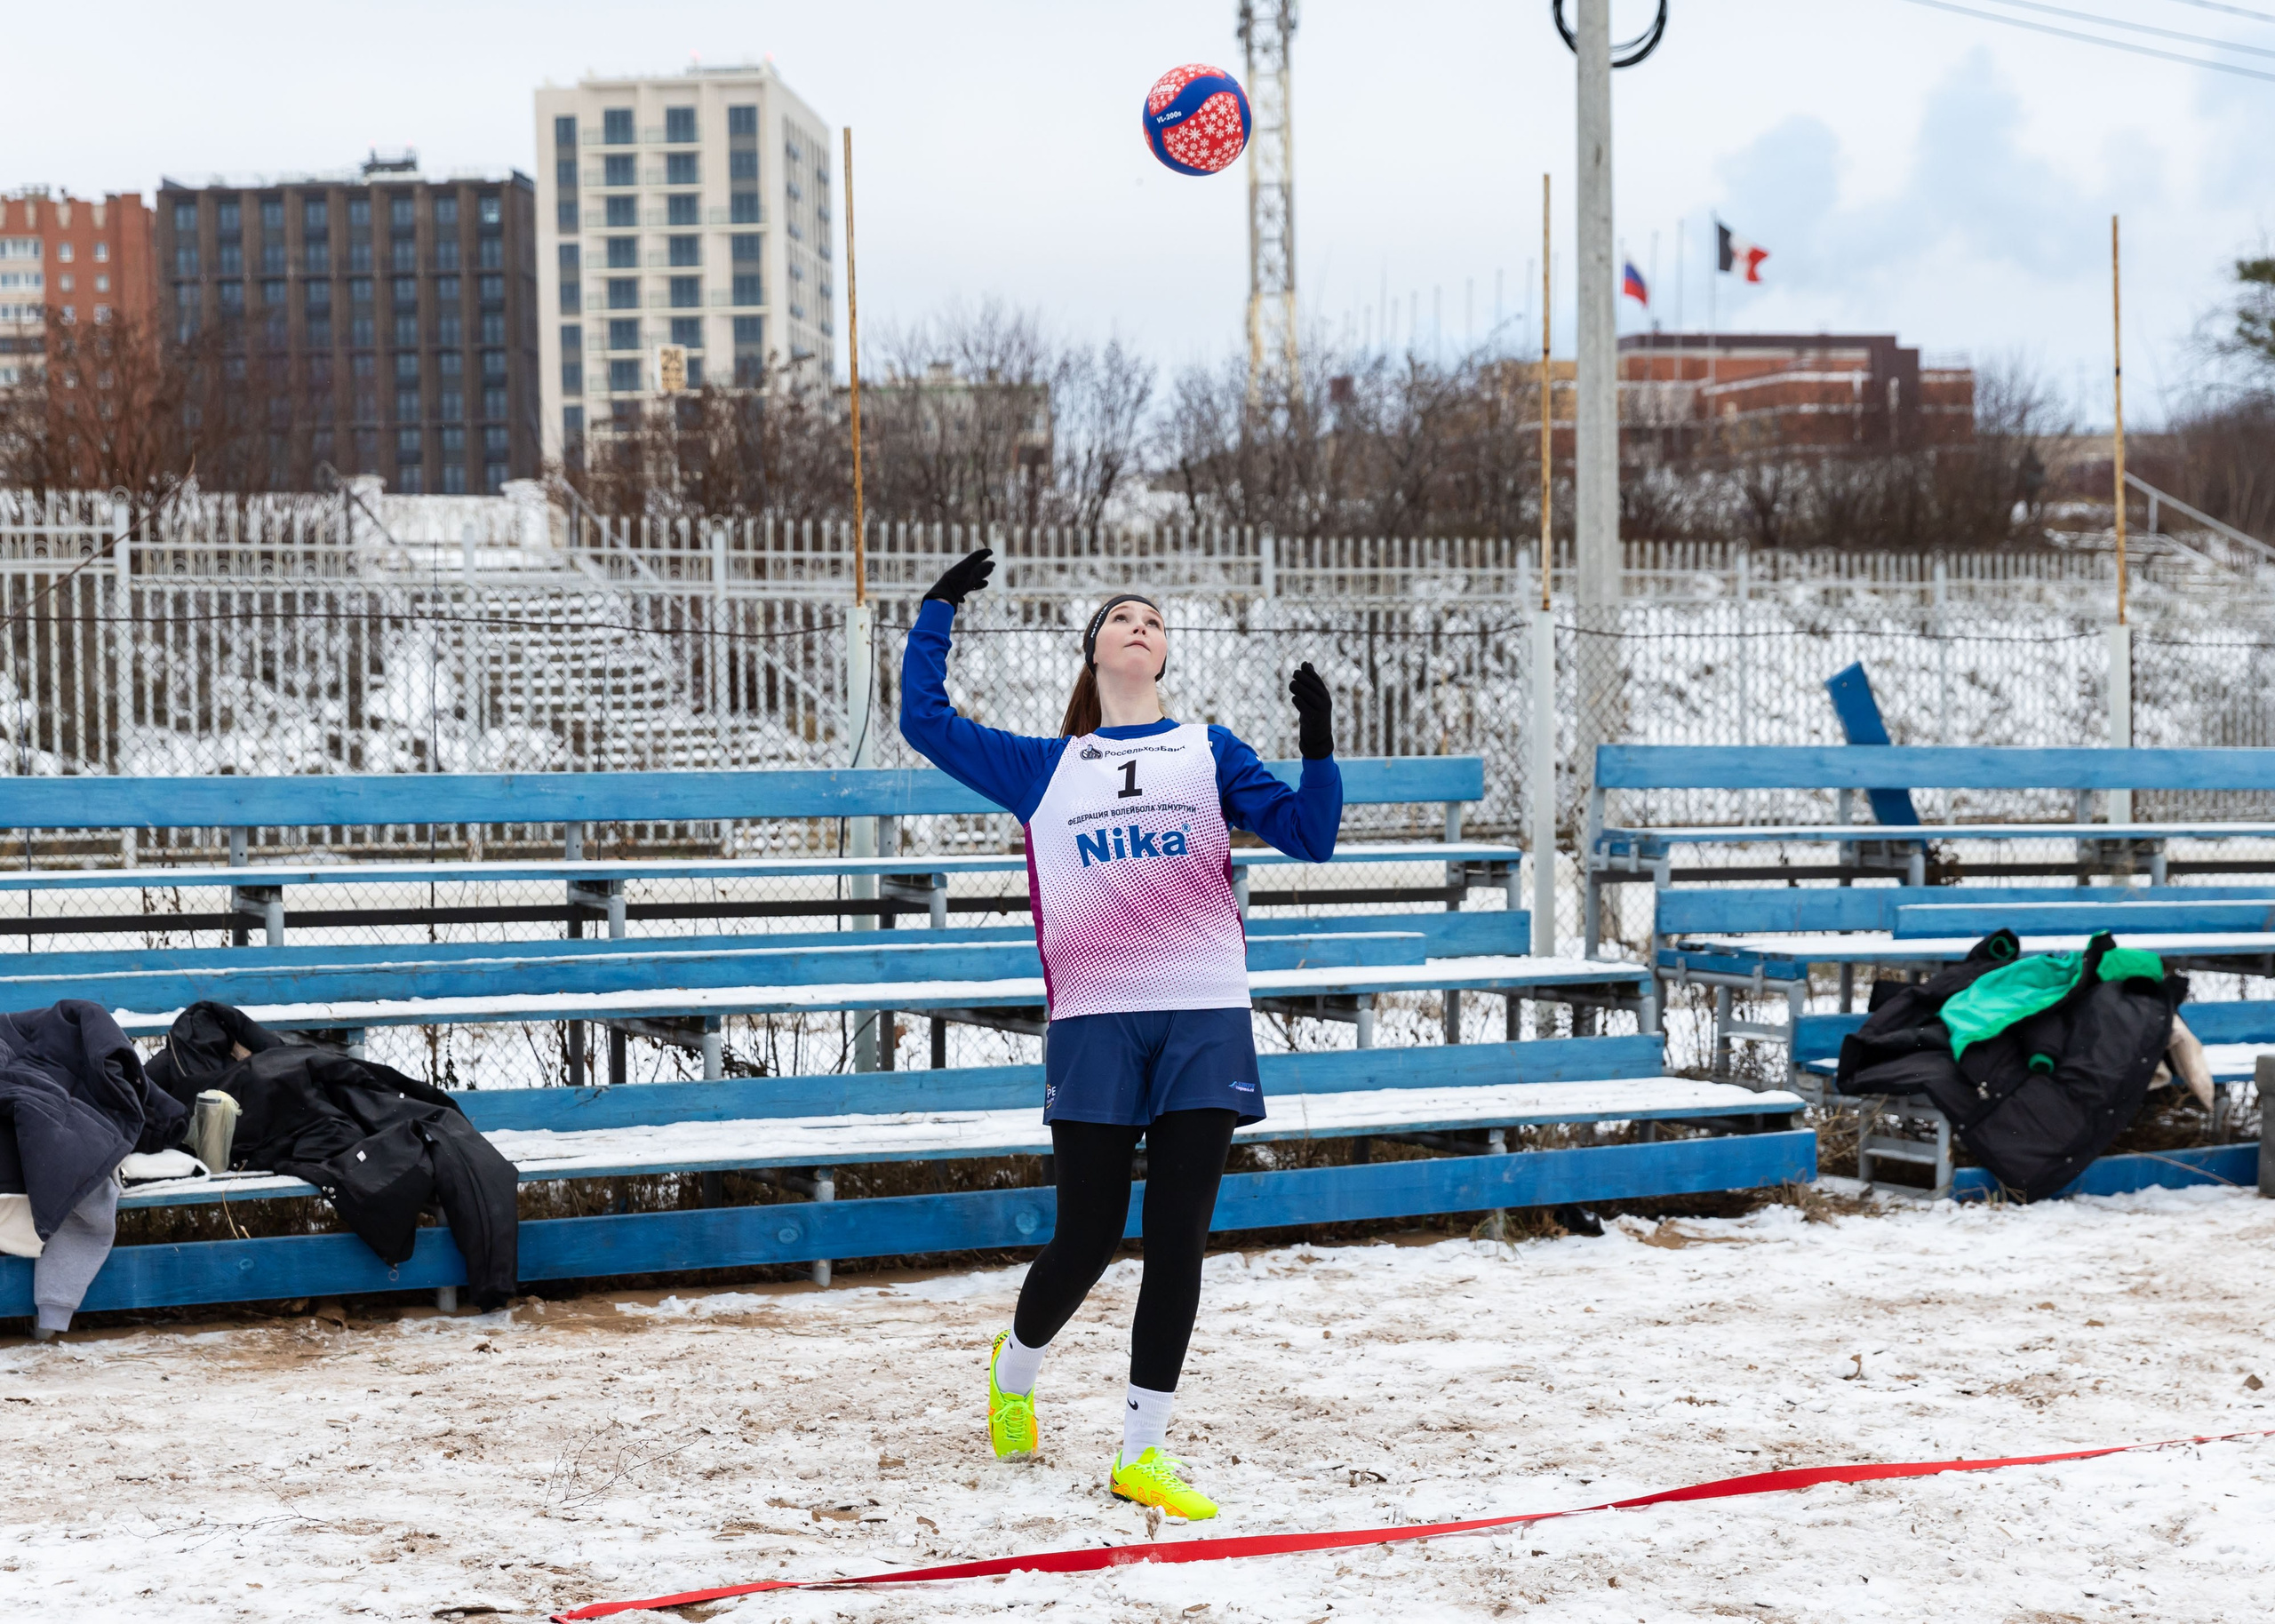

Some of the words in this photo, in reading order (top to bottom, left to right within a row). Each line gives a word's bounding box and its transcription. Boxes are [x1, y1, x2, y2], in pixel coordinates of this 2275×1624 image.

[1156, 111, 1182, 123] VL-200s
[1117, 760, 1143, 799] 1
[1067, 810, 1109, 826] ФЕДЕРАЦИЯ
[1111, 805, 1155, 817] ВОЛЕЙБОЛА
[1157, 803, 1197, 814] УДМУРТИИ
